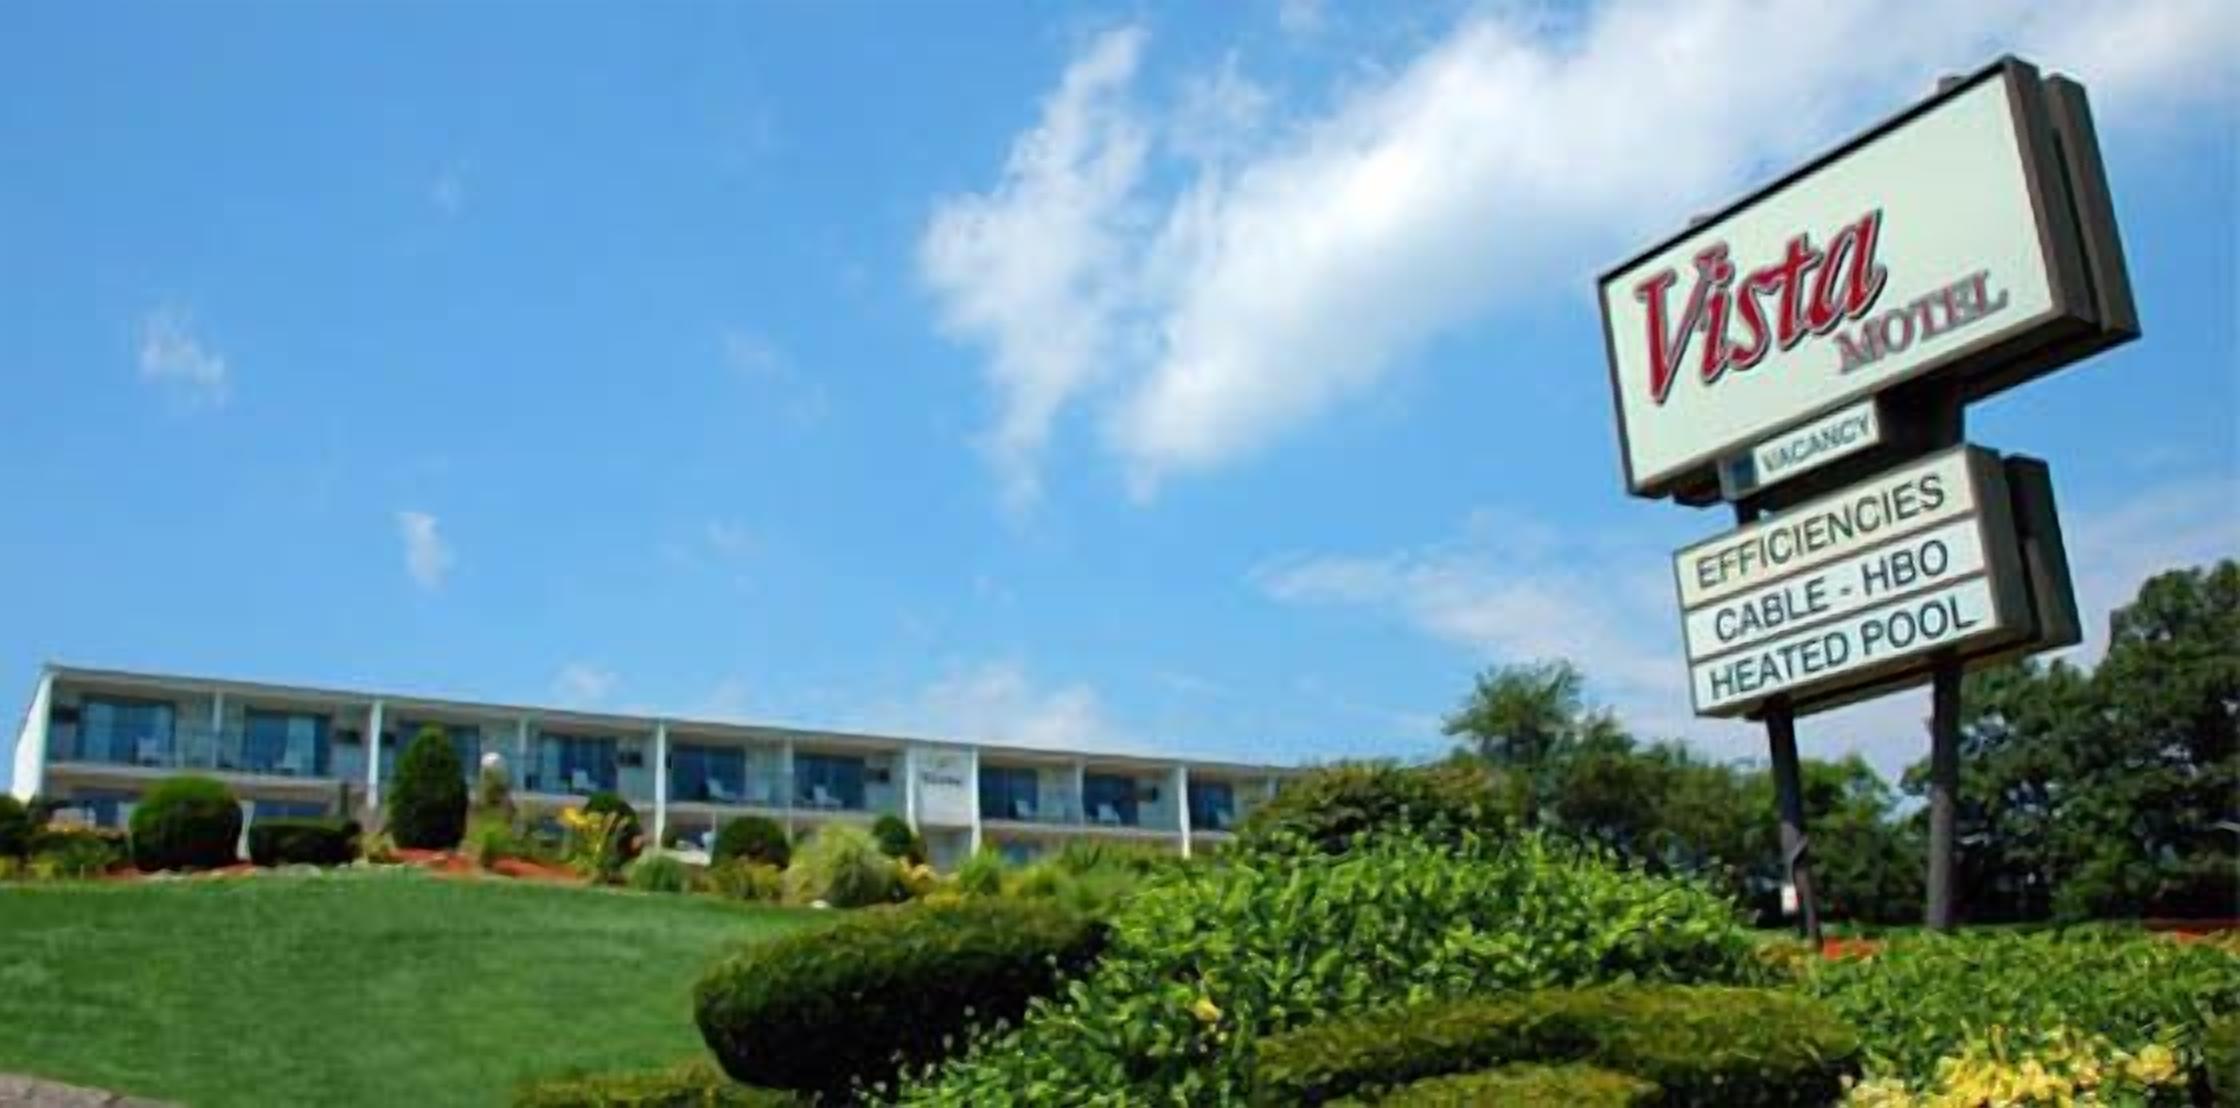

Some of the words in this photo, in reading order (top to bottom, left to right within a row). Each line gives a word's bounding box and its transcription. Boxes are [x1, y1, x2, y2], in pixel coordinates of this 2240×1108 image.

[1634, 207, 1887, 405] Vista
[1831, 269, 2008, 374] MOTEL
[1760, 413, 1870, 472] VACANCY
[1696, 474, 1944, 588] EFFICIENCIES
[1715, 577, 1830, 643] CABLE
[1861, 539, 1949, 597] HBO
[1708, 631, 1848, 699] HEATED
[1860, 595, 1978, 657] POOL
